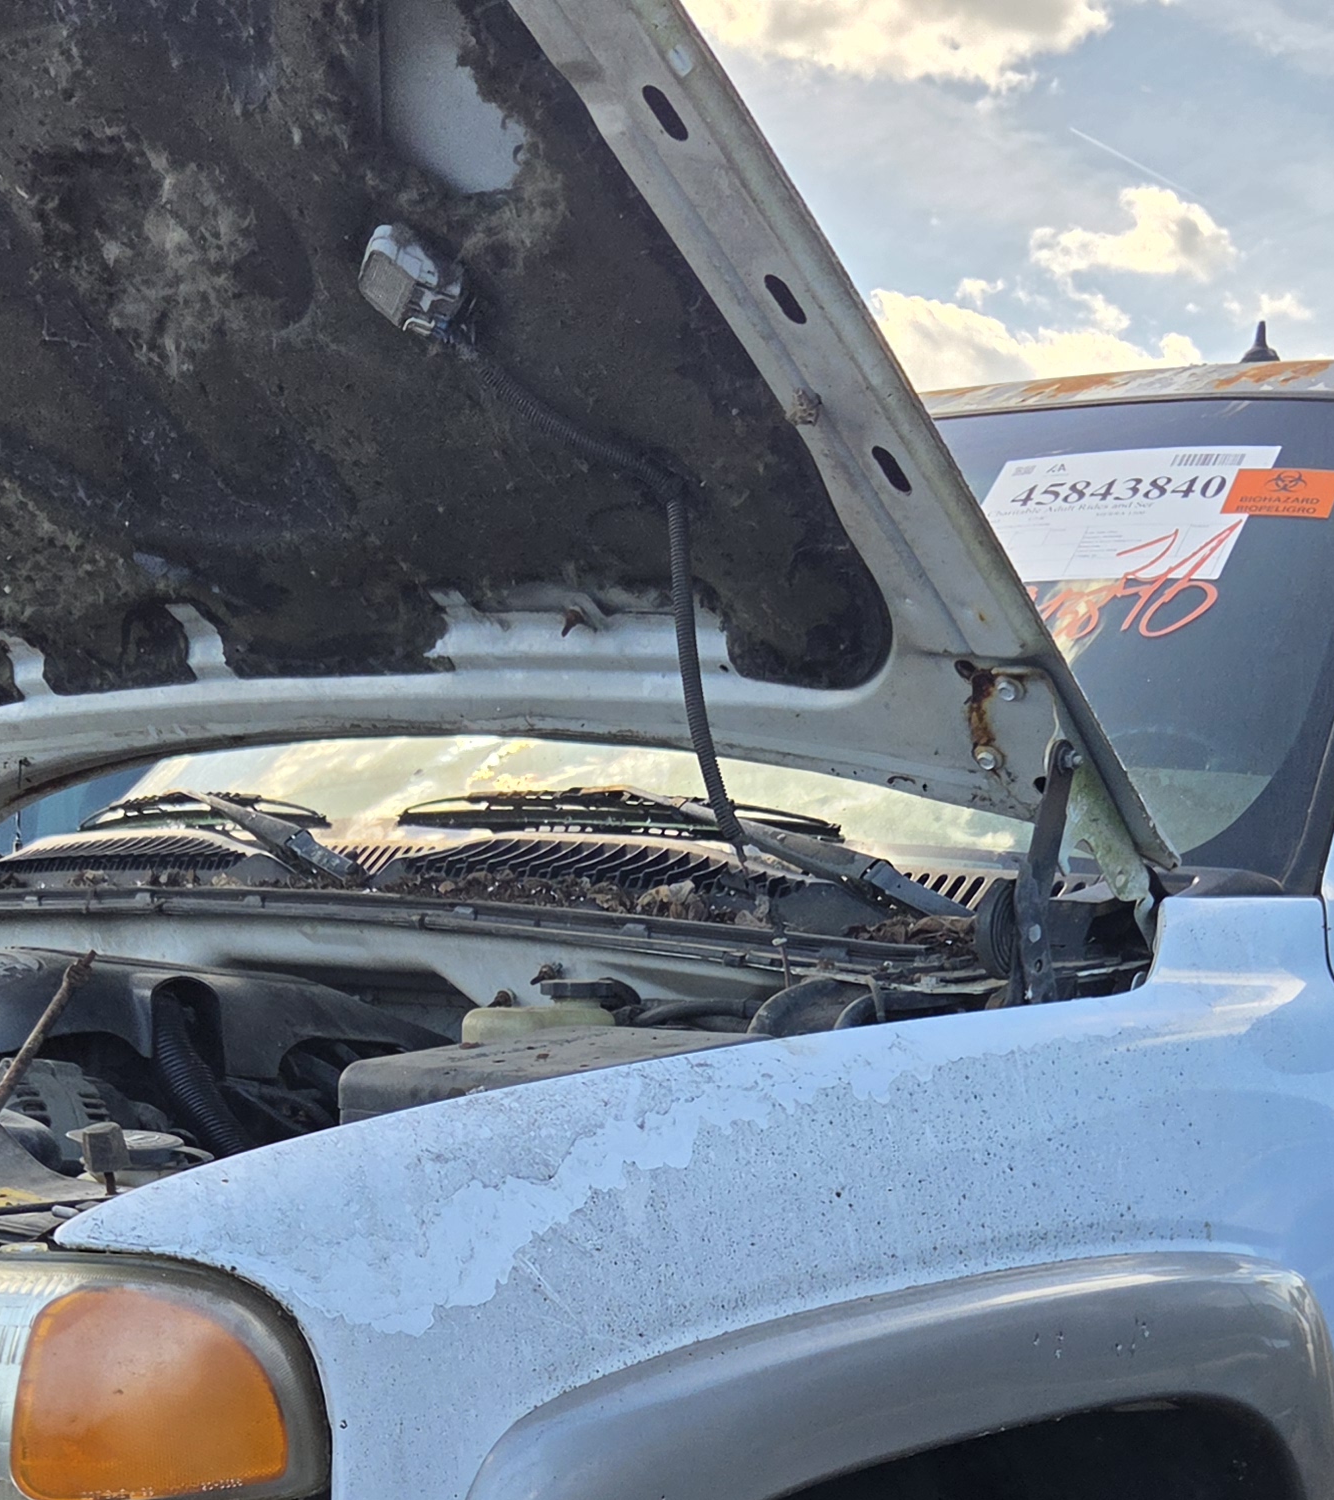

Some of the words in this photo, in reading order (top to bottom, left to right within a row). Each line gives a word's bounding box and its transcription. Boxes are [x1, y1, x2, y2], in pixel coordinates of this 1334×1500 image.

[1011, 475, 1227, 507] 45843840
[1240, 496, 1320, 505] BIOHAZARD
[987, 506, 1040, 517] Charitable
[1046, 504, 1076, 513] Adult
[1078, 502, 1109, 511] Rides
[1112, 501, 1133, 509] and
[1236, 505, 1317, 515] BIOPELIGRO
